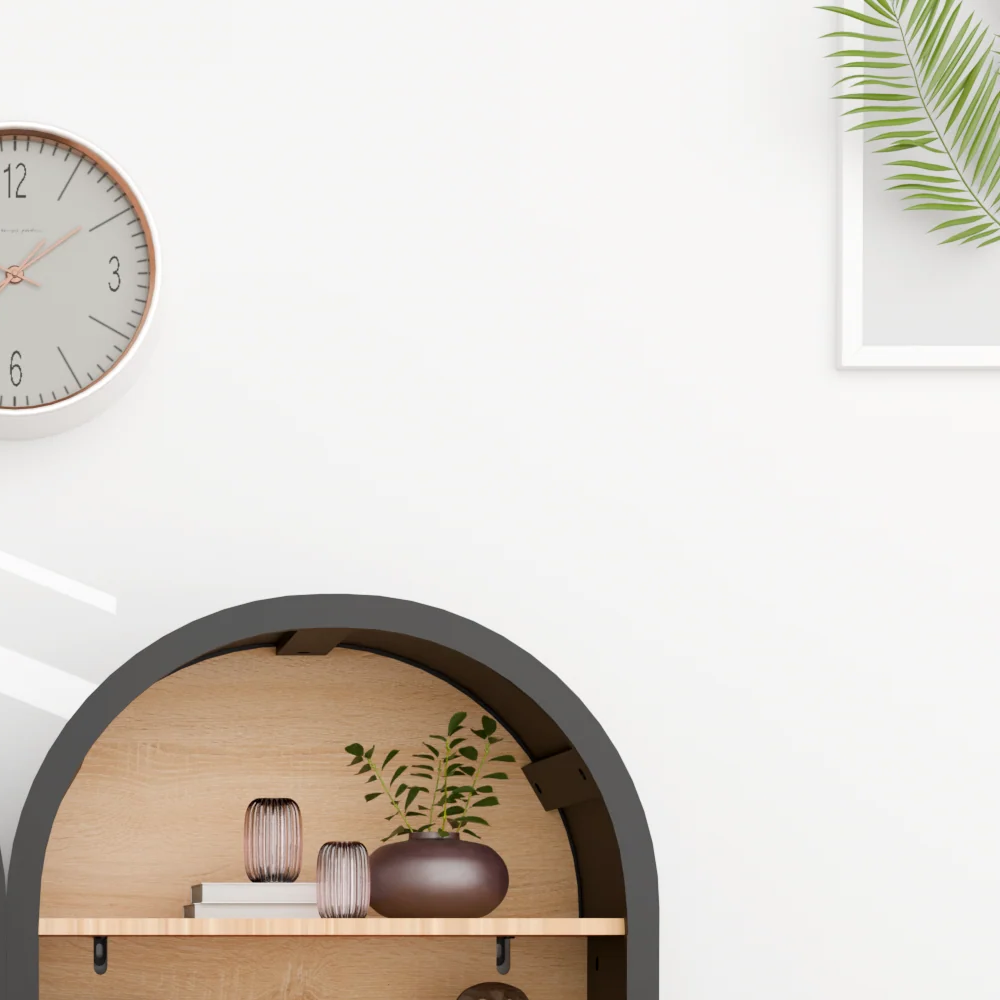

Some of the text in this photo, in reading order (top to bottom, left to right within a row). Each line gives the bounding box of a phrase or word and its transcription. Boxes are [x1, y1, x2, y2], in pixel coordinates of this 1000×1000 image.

[3, 162, 27, 198] 12
[107, 255, 121, 292] 3
[9, 350, 23, 387] 6
